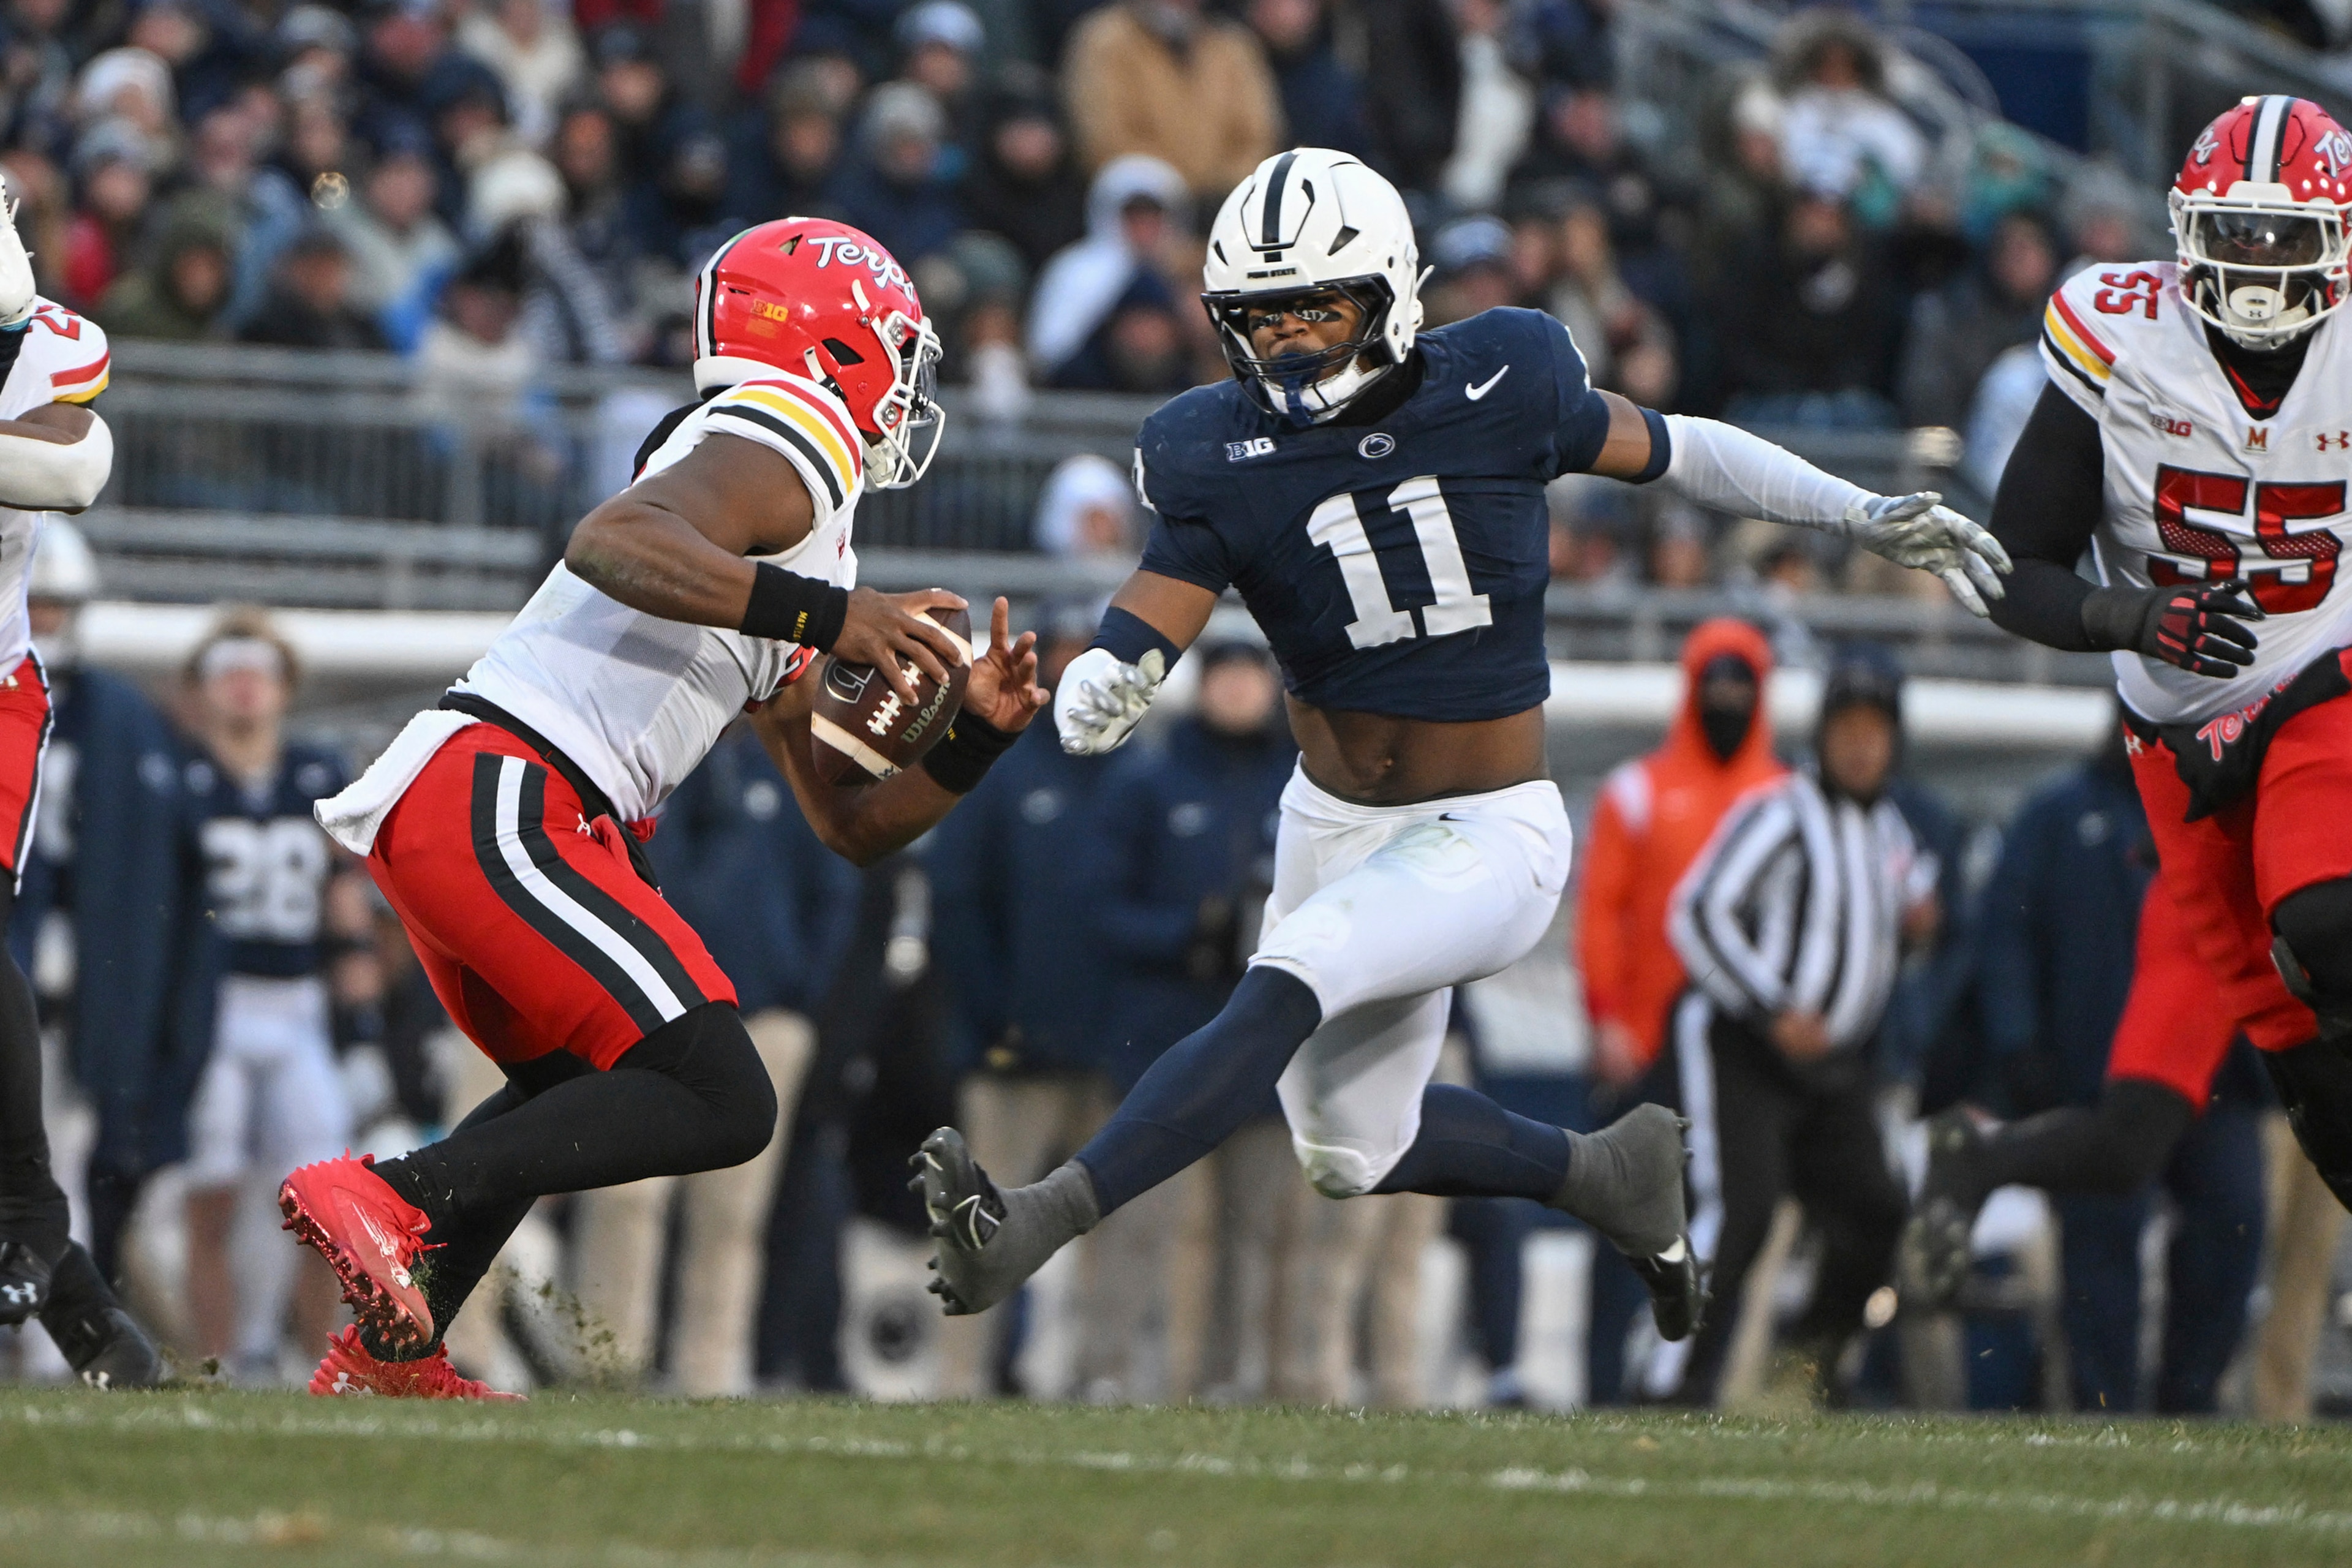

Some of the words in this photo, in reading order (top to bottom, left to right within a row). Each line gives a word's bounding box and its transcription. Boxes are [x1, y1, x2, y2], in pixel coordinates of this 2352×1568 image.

[807, 236, 915, 303] Terps
[2094, 270, 2163, 320] 55
[2245, 426, 2269, 451] M
[1306, 475, 1493, 650] 11
[2147, 462, 2346, 615] 55
[900, 682, 951, 743] Wilson
